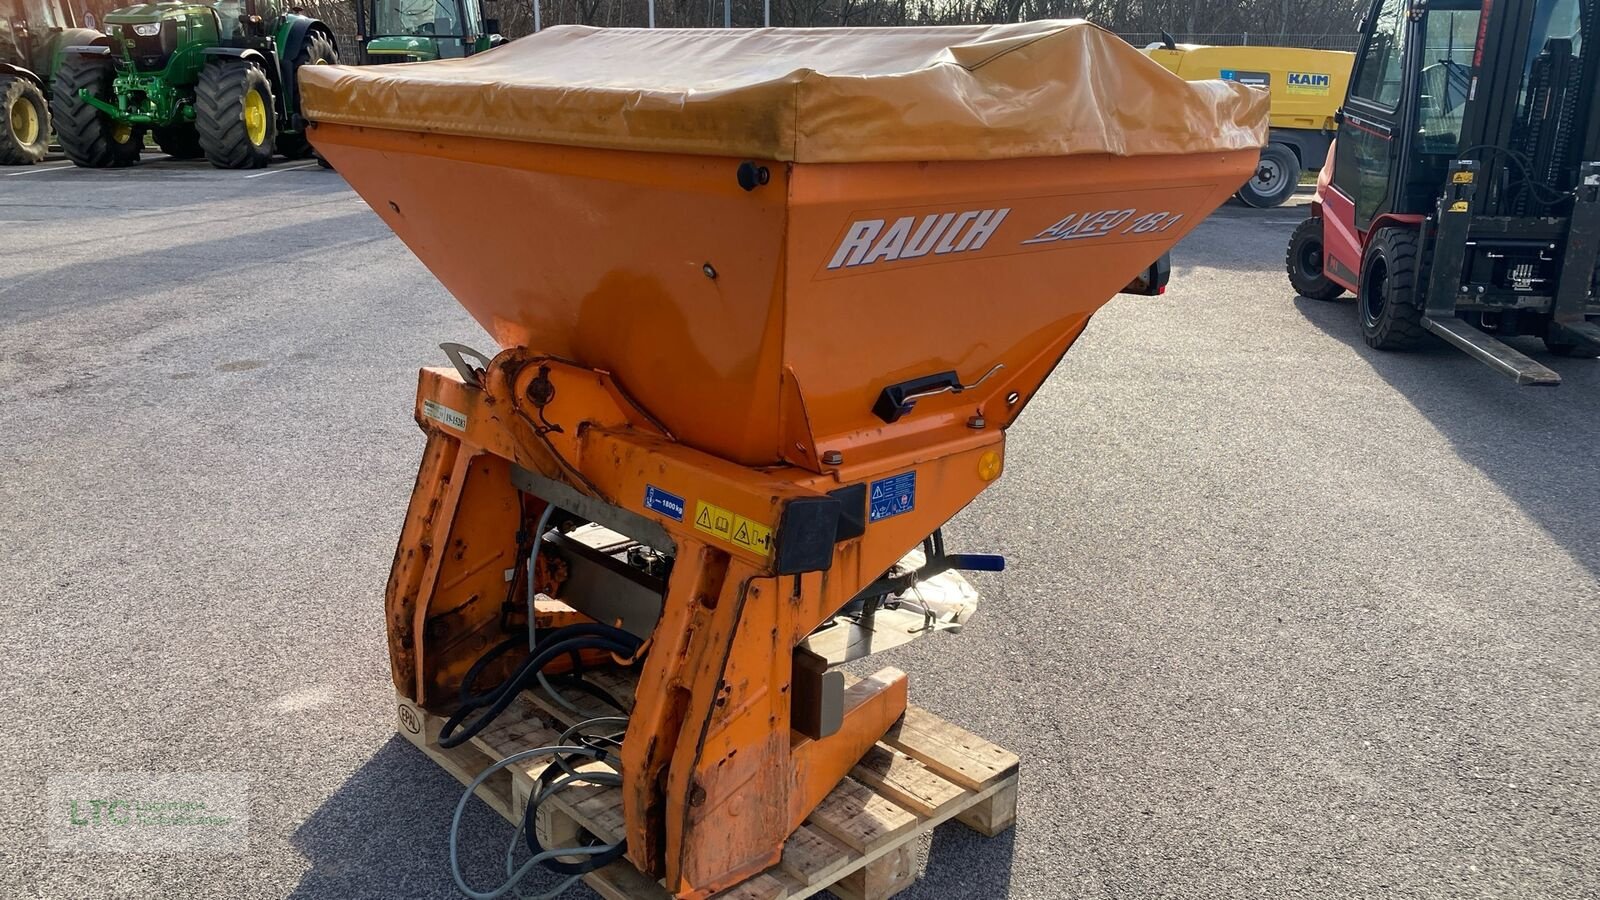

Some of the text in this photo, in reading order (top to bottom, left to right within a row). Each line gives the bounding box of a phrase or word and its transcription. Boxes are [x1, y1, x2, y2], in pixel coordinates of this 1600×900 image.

[1289, 73, 1329, 87] KAIM
[826, 208, 1184, 270] RAUCH AXEO 18.1
[401, 706, 418, 732] EPAL
